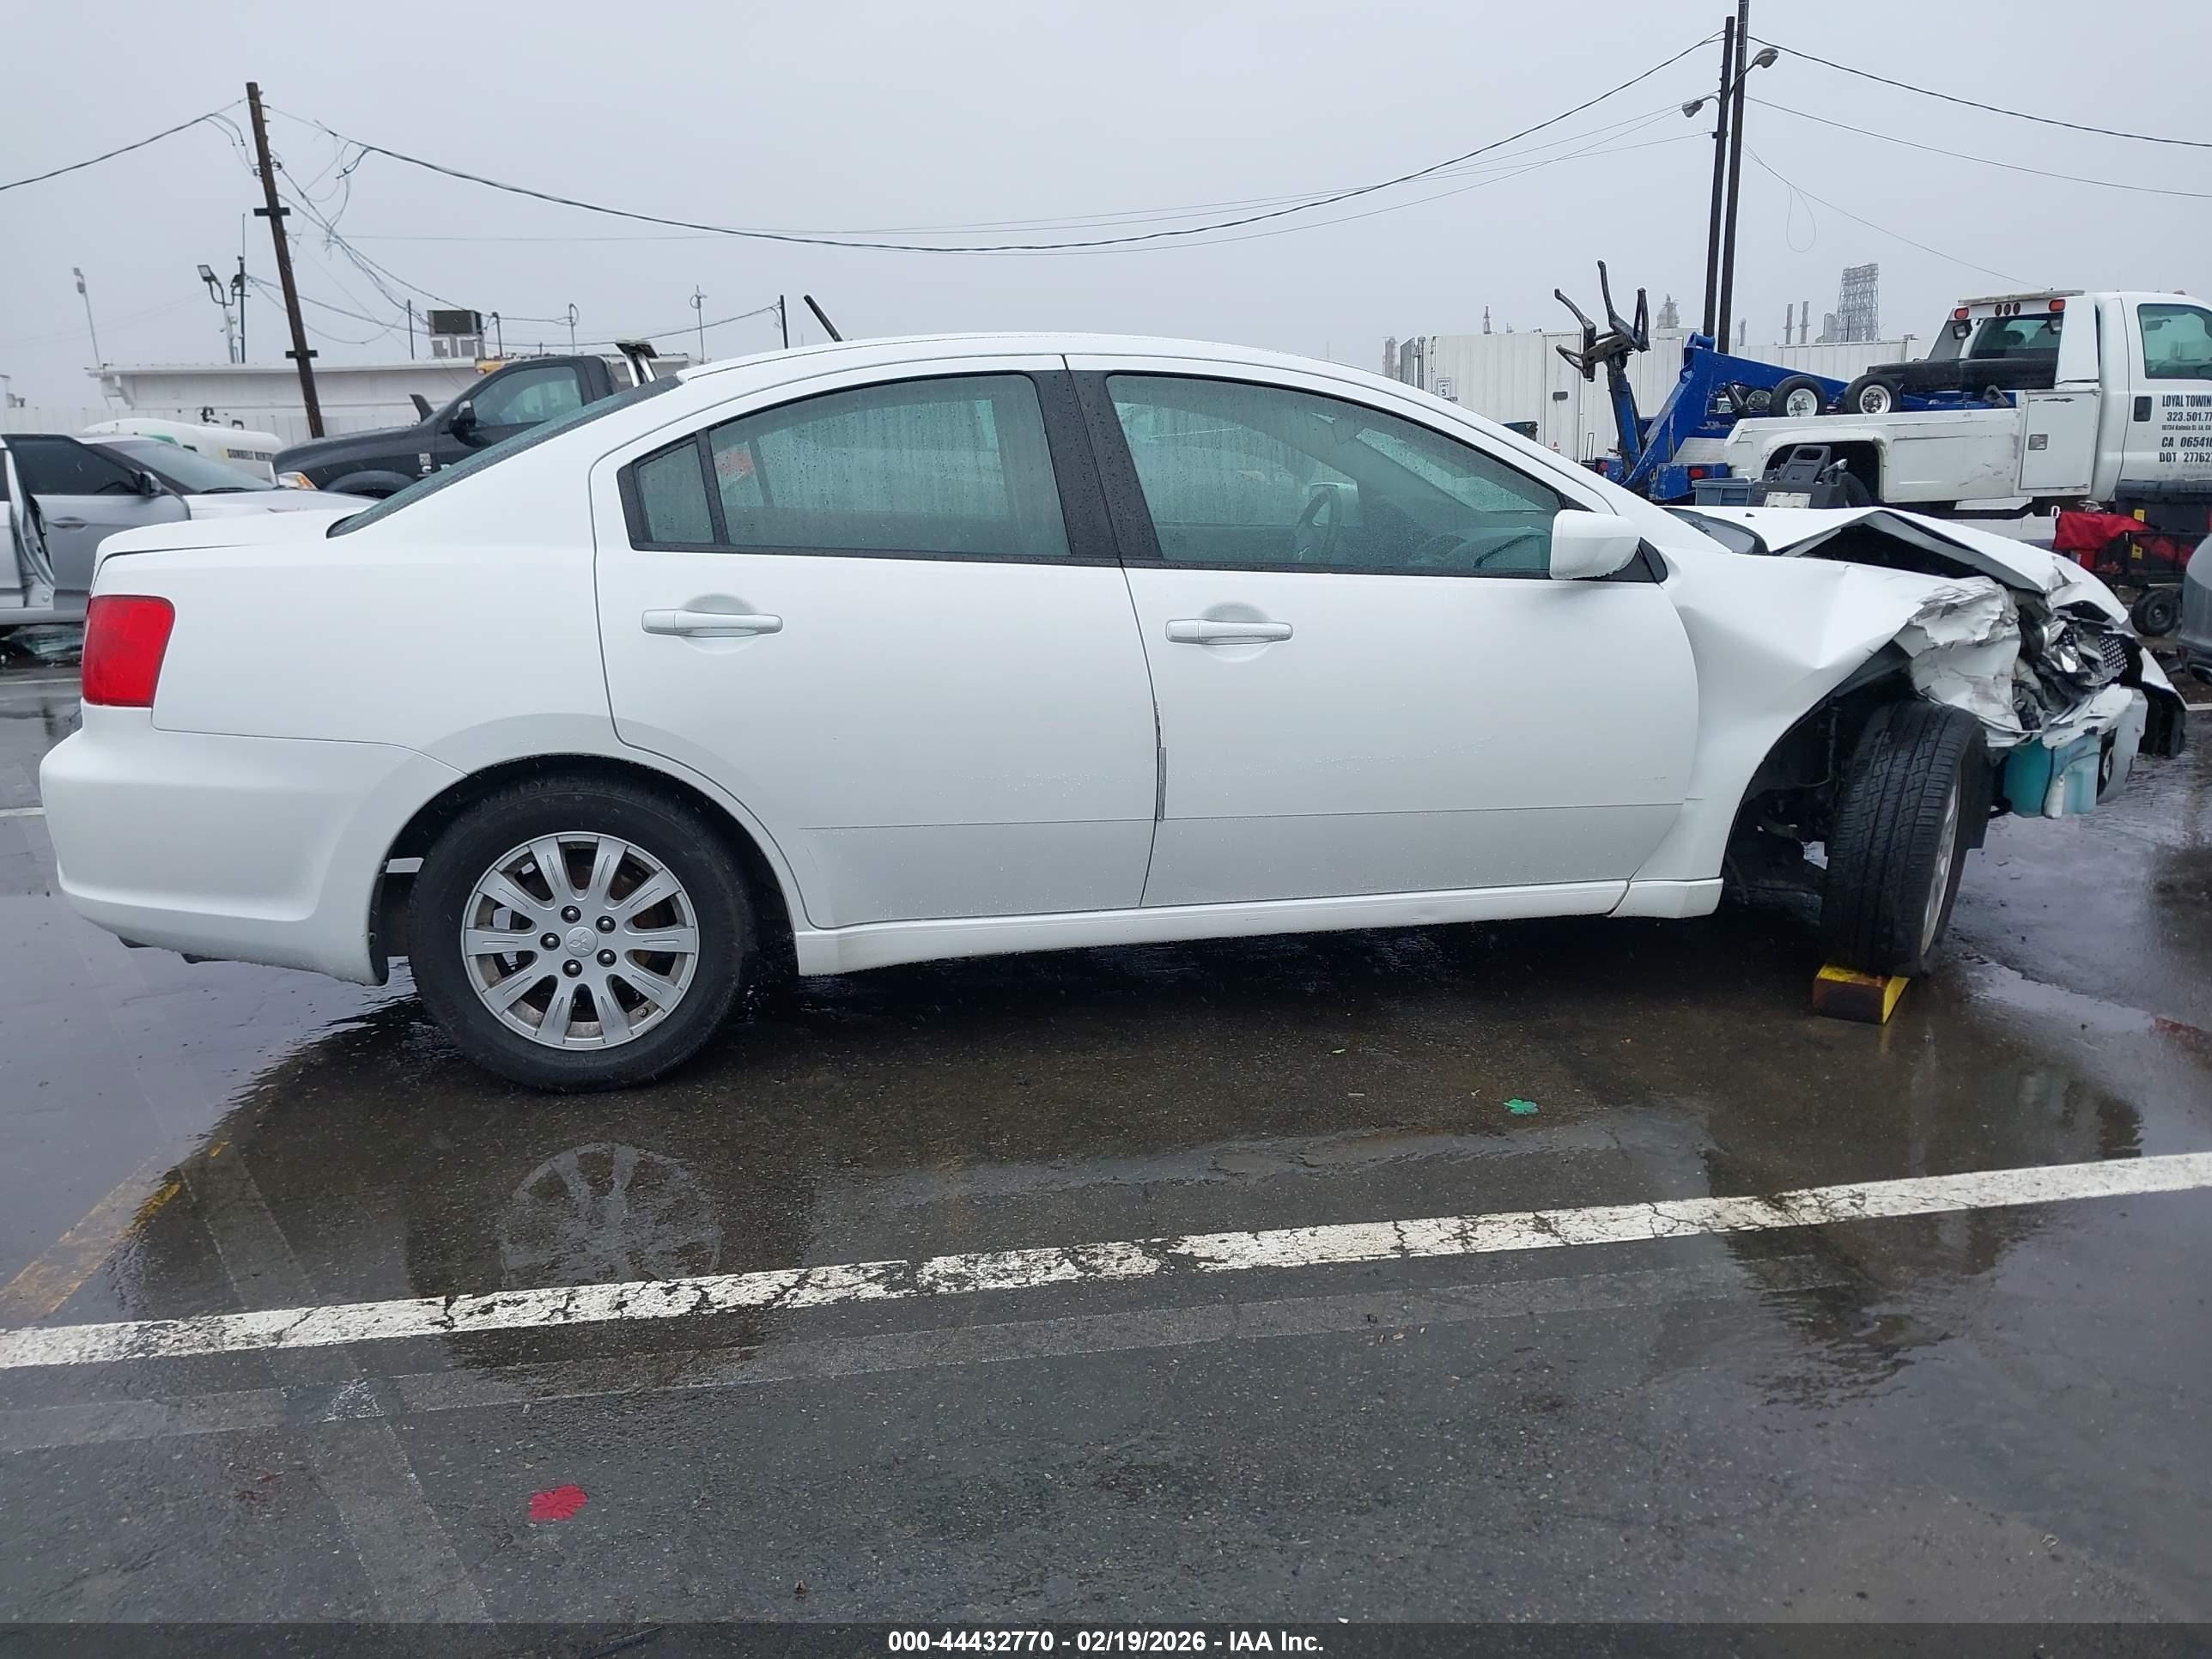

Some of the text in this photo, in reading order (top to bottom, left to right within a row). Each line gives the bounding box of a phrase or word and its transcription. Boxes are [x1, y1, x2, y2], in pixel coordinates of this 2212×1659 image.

[2162, 395, 2184, 407] LOYAL
[2161, 436, 2174, 447] CA
[2159, 452, 2212, 463] DOT 27762
